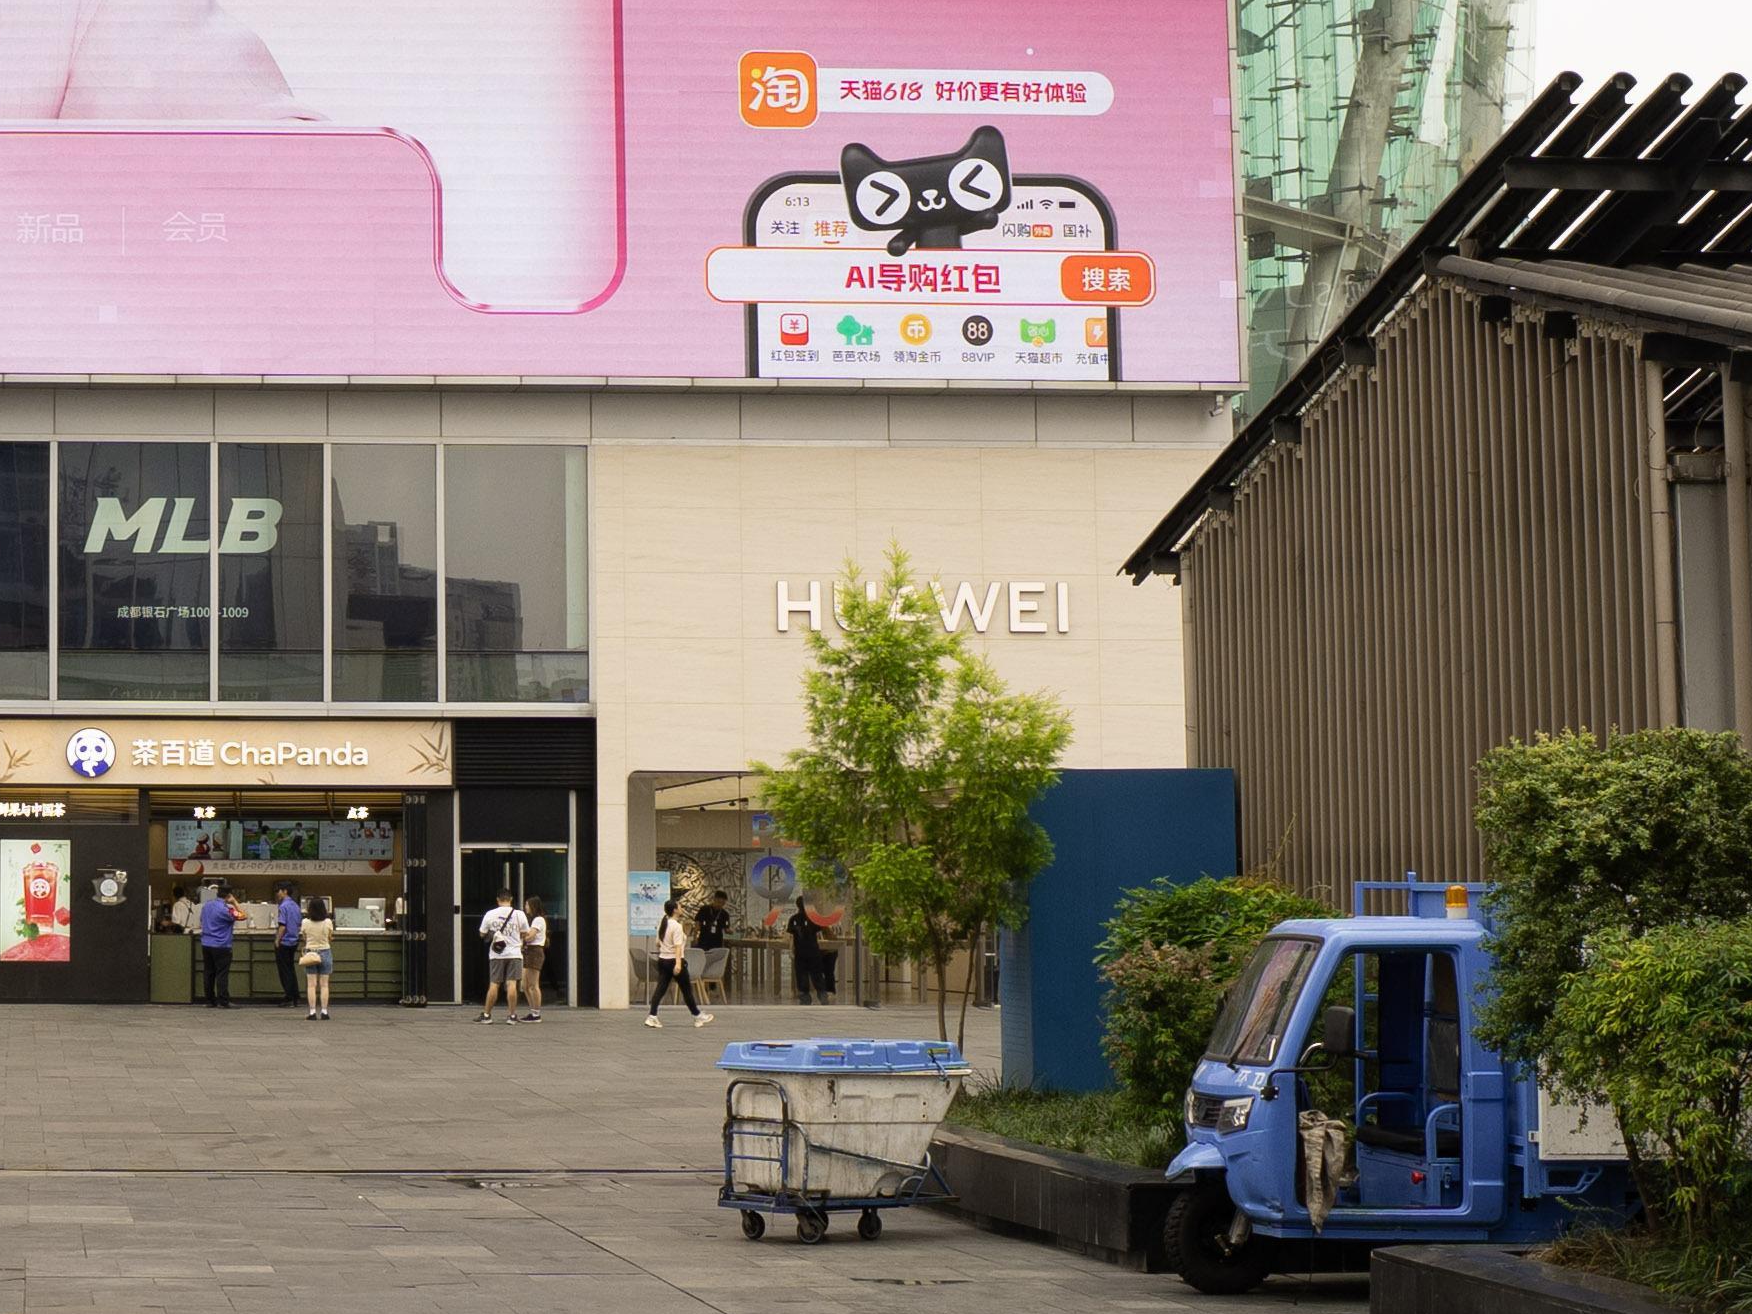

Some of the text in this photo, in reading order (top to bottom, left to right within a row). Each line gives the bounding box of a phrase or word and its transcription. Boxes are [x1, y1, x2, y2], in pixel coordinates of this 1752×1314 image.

[748, 65, 810, 113] 淘
[840, 79, 1087, 104] 天猫618 好价更有好体验
[785, 196, 810, 207] 6:13
[16, 213, 84, 245] 新品
[162, 212, 229, 244] 会员
[770, 220, 800, 236] 关注
[814, 220, 848, 237] 推荐
[1002, 222, 1031, 238] 闪购
[1063, 224, 1092, 239] 国补
[845, 263, 1002, 293] AI导购红包
[1082, 266, 1132, 293] 搜索
[966, 321, 989, 341] 88
[770, 349, 820, 363] 红包签到
[832, 349, 881, 363] 芭芭农场
[894, 350, 942, 364] 领淘金币
[961, 352, 996, 363] 88VIP
[1015, 351, 1063, 365] 天猫超市
[83, 496, 284, 554] MLB
[117, 605, 250, 619] 成都银石广场100-1009
[131, 738, 369, 767] 茶百道 ChaPanda
